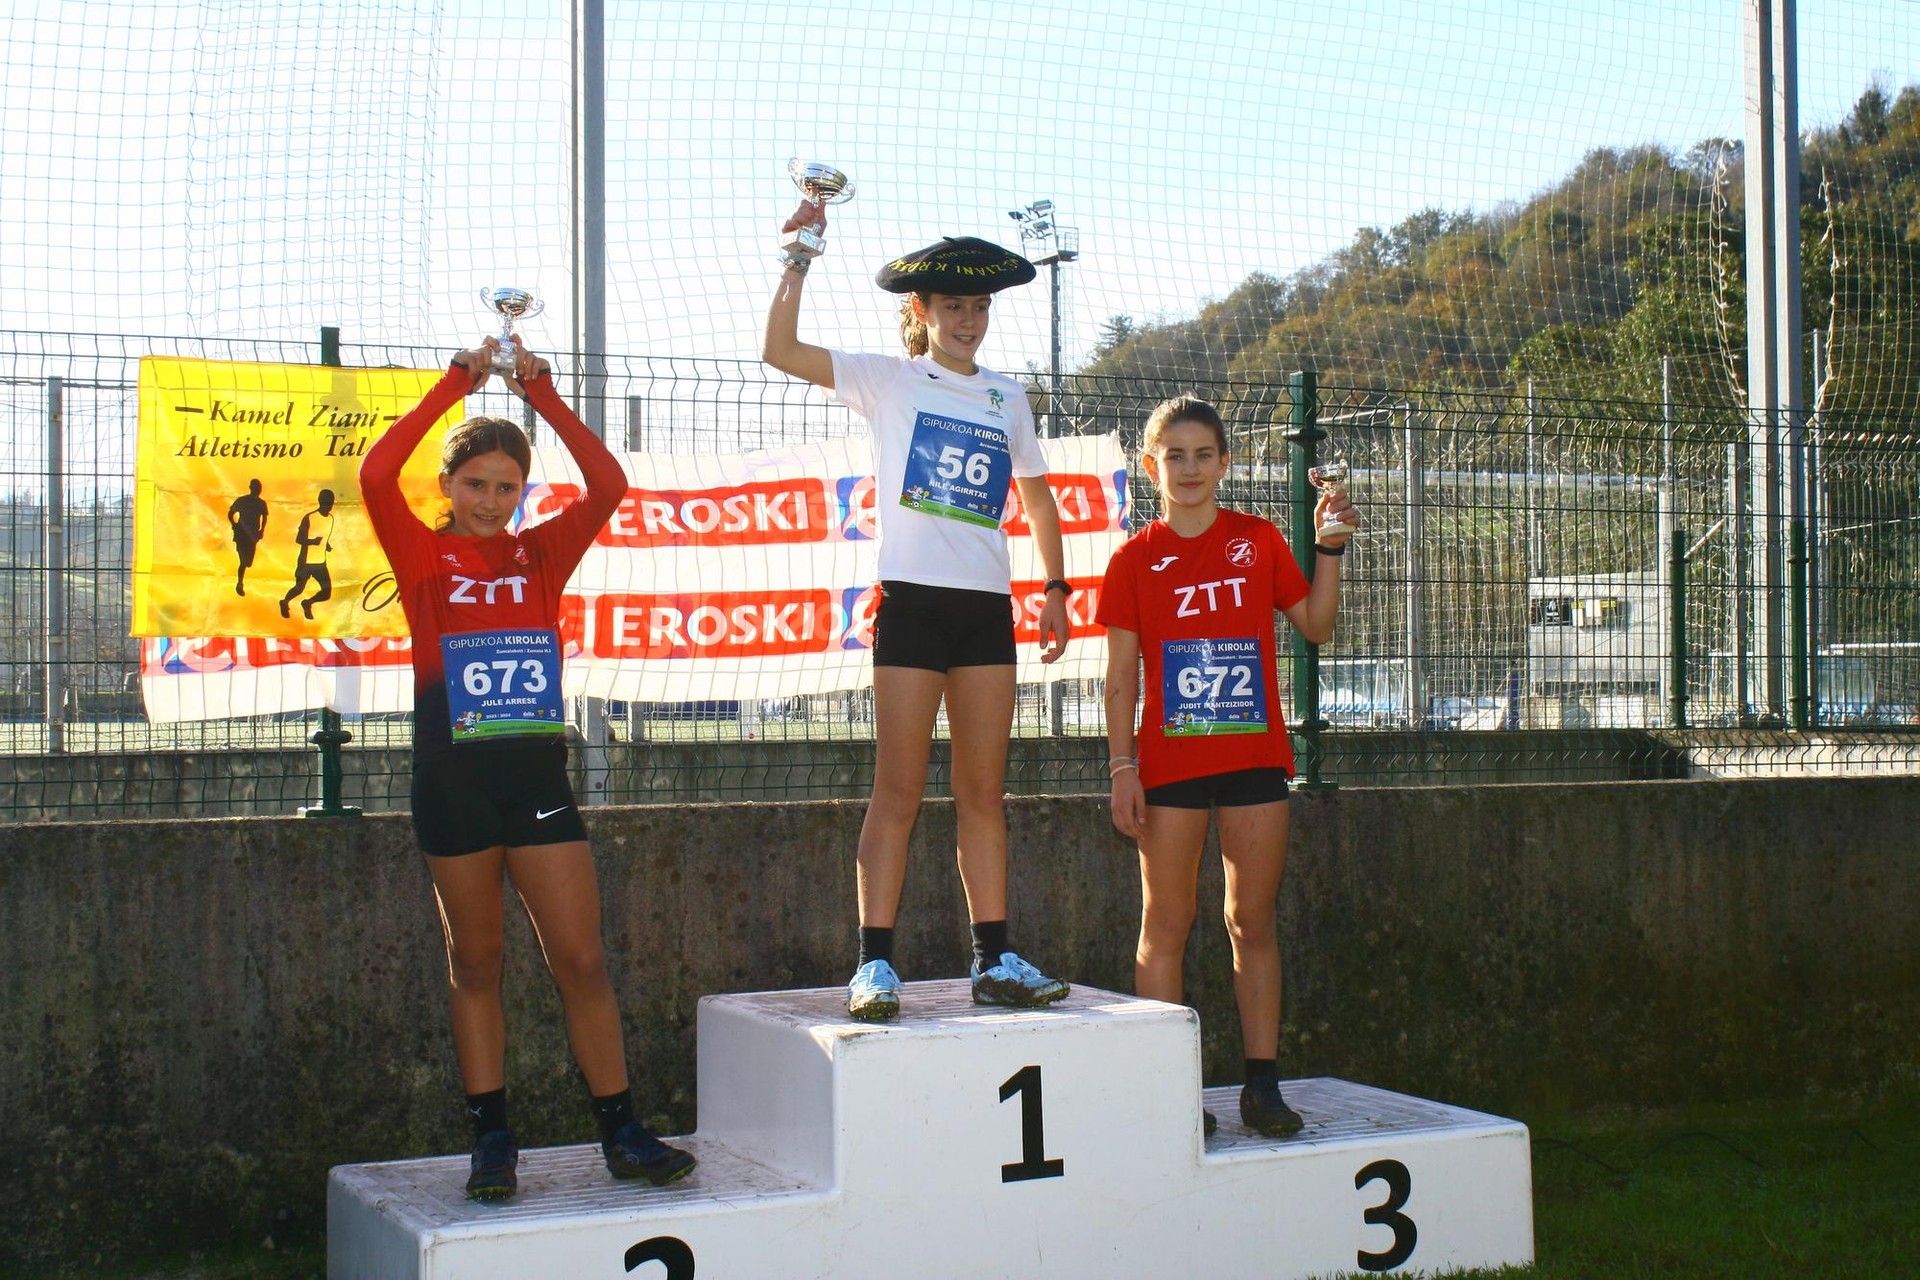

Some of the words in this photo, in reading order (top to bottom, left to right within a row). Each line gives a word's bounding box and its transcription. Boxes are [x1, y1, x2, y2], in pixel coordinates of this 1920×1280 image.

[209, 400, 295, 426] Kamel
[308, 404, 380, 428] Ziani
[922, 417, 973, 436] GIPUZKOA
[175, 434, 304, 459] Atletismo
[324, 434, 367, 457] Tal
[936, 445, 992, 486] 56
[609, 491, 809, 537] EROSKI
[449, 575, 528, 605] ZTT
[1174, 577, 1247, 619] ZTT
[612, 602, 816, 647] EROSKI
[449, 637, 503, 649] GIPUZKOA
[505, 635, 549, 645] KIROLAK
[1218, 642, 1255, 652] KIROLAK
[463, 659, 547, 696] 673
[1177, 665, 1253, 699] 672
[481, 698, 503, 707] JULE
[505, 697, 537, 705] ARRESE
[1178, 702, 1202, 710] JUDIT
[1000, 1066, 1064, 1183] 1
[1356, 1159, 1418, 1272] 3
